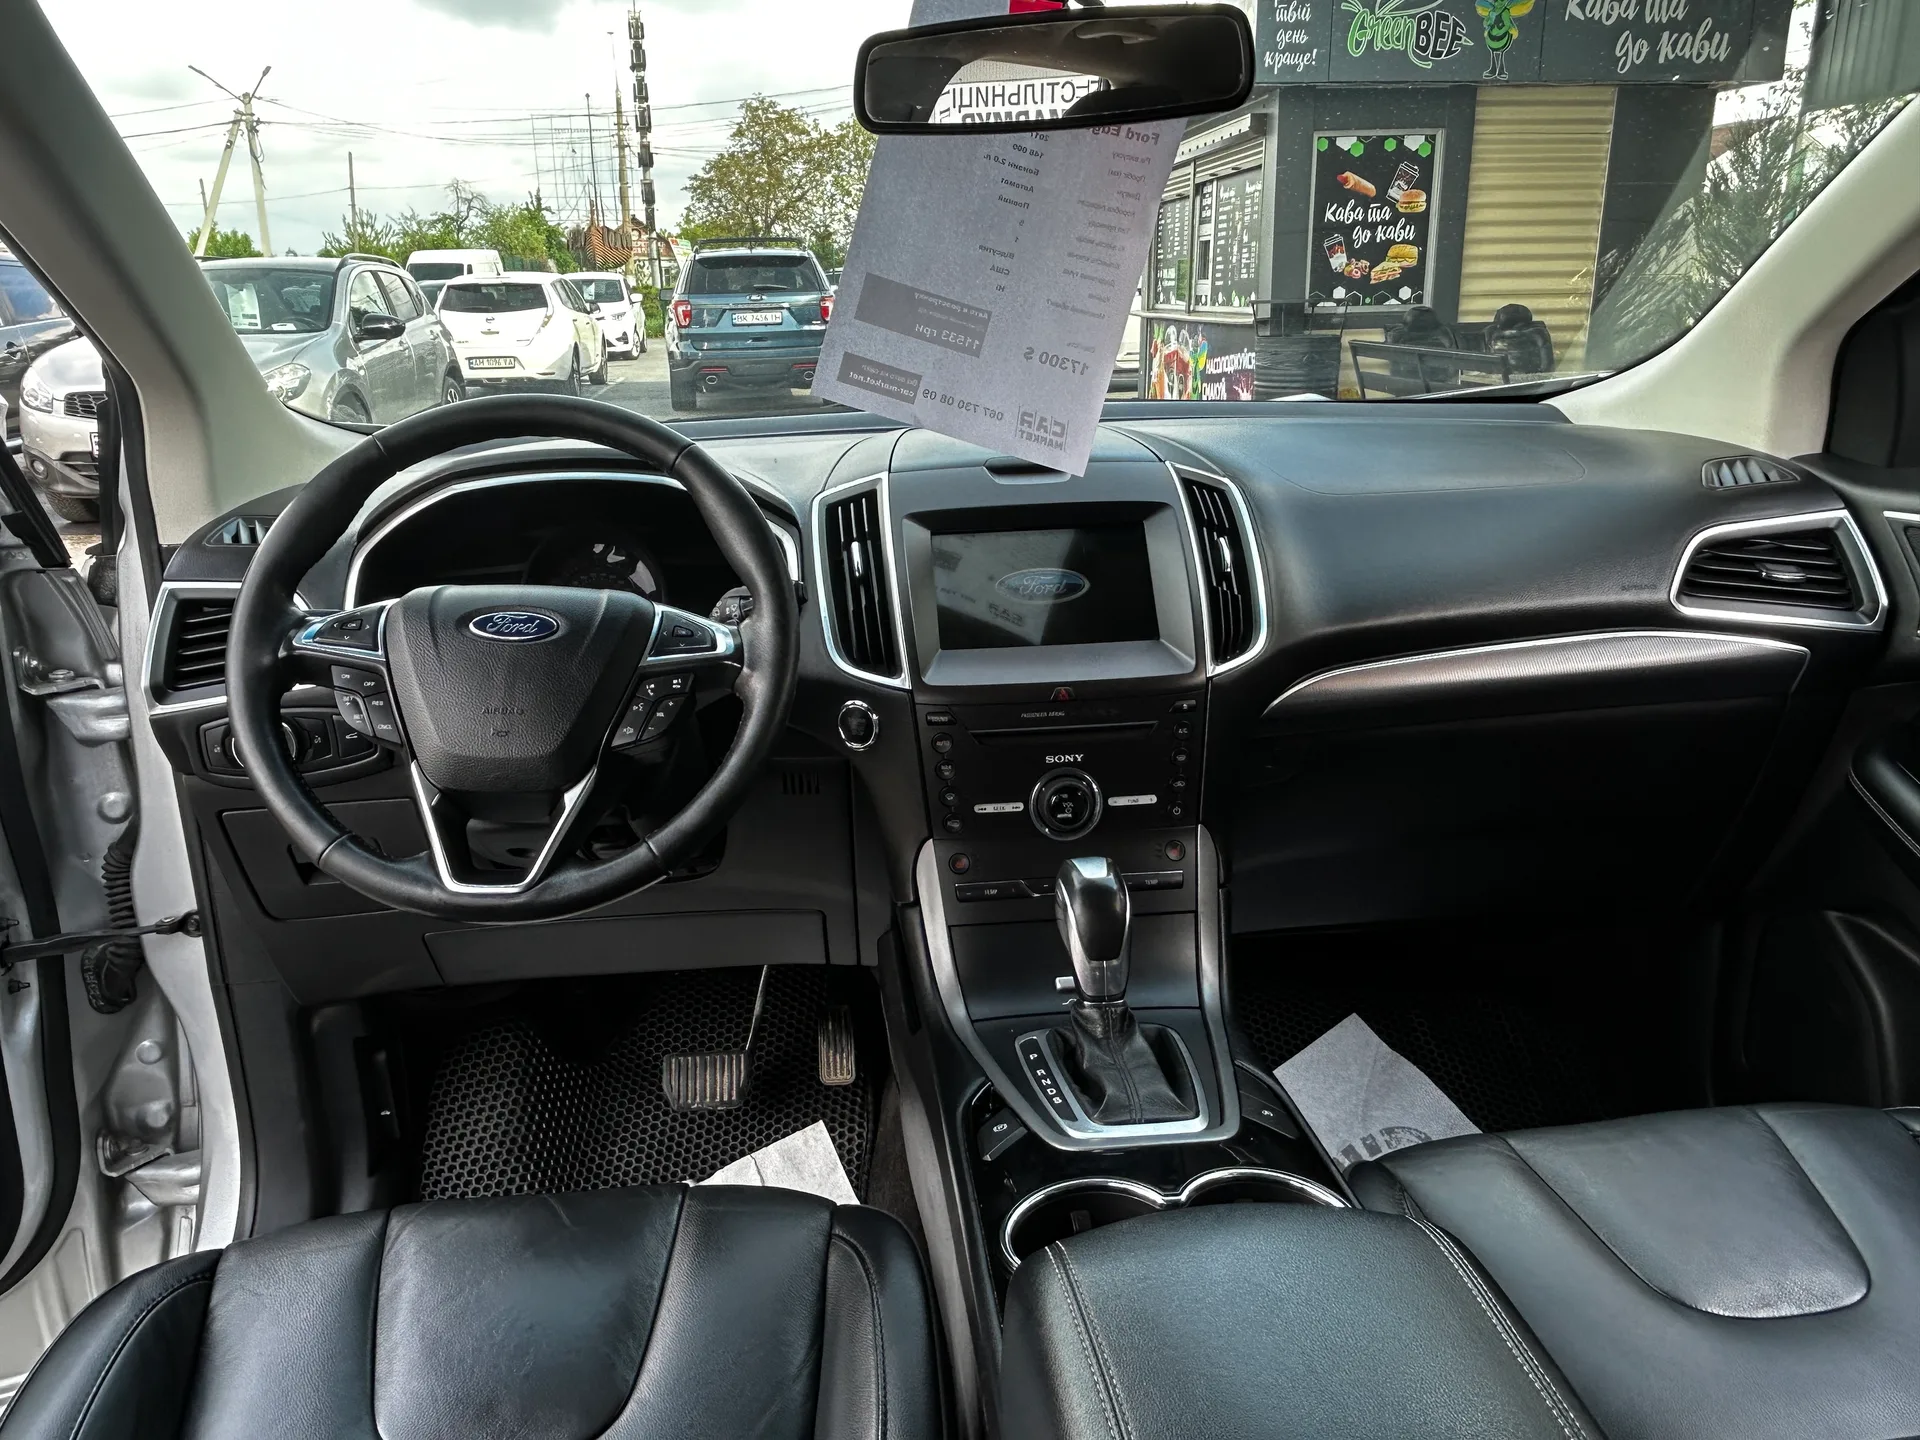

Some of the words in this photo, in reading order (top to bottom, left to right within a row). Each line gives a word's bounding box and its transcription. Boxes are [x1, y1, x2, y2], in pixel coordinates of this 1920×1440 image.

[1276, 0, 1311, 22] твій
[1276, 29, 1308, 50] день
[1615, 30, 1650, 73] до
[1656, 17, 1731, 64] кави
[1264, 48, 1317, 75] краще!
[1324, 199, 1365, 224] Кава
[1367, 203, 1393, 223] та
[1352, 225, 1372, 249] до
[1374, 217, 1416, 242] кави
[1019, 575, 1067, 596] Ford
[485, 612, 541, 634] Ford
[1045, 753, 1084, 764] SONY
[1041, 1078, 1052, 1086] N
